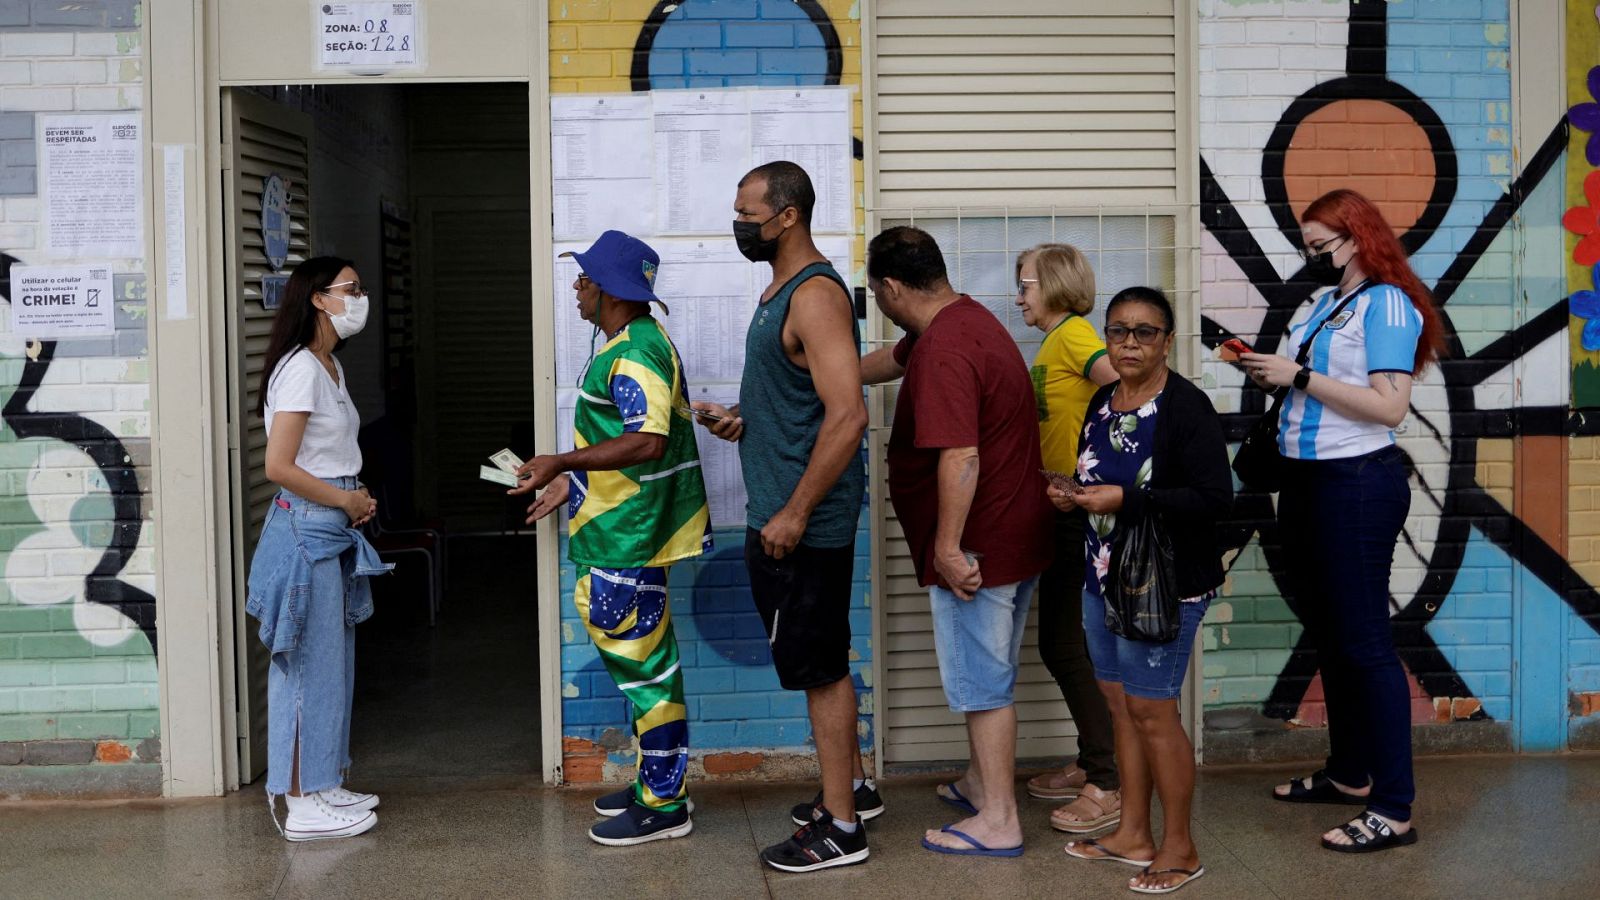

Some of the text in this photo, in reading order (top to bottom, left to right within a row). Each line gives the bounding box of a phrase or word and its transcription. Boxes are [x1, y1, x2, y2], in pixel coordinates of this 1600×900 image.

[325, 24, 360, 33] ZONA:
[325, 41, 367, 52] SEÇÃO:
[22, 294, 76, 306] CRIME!
